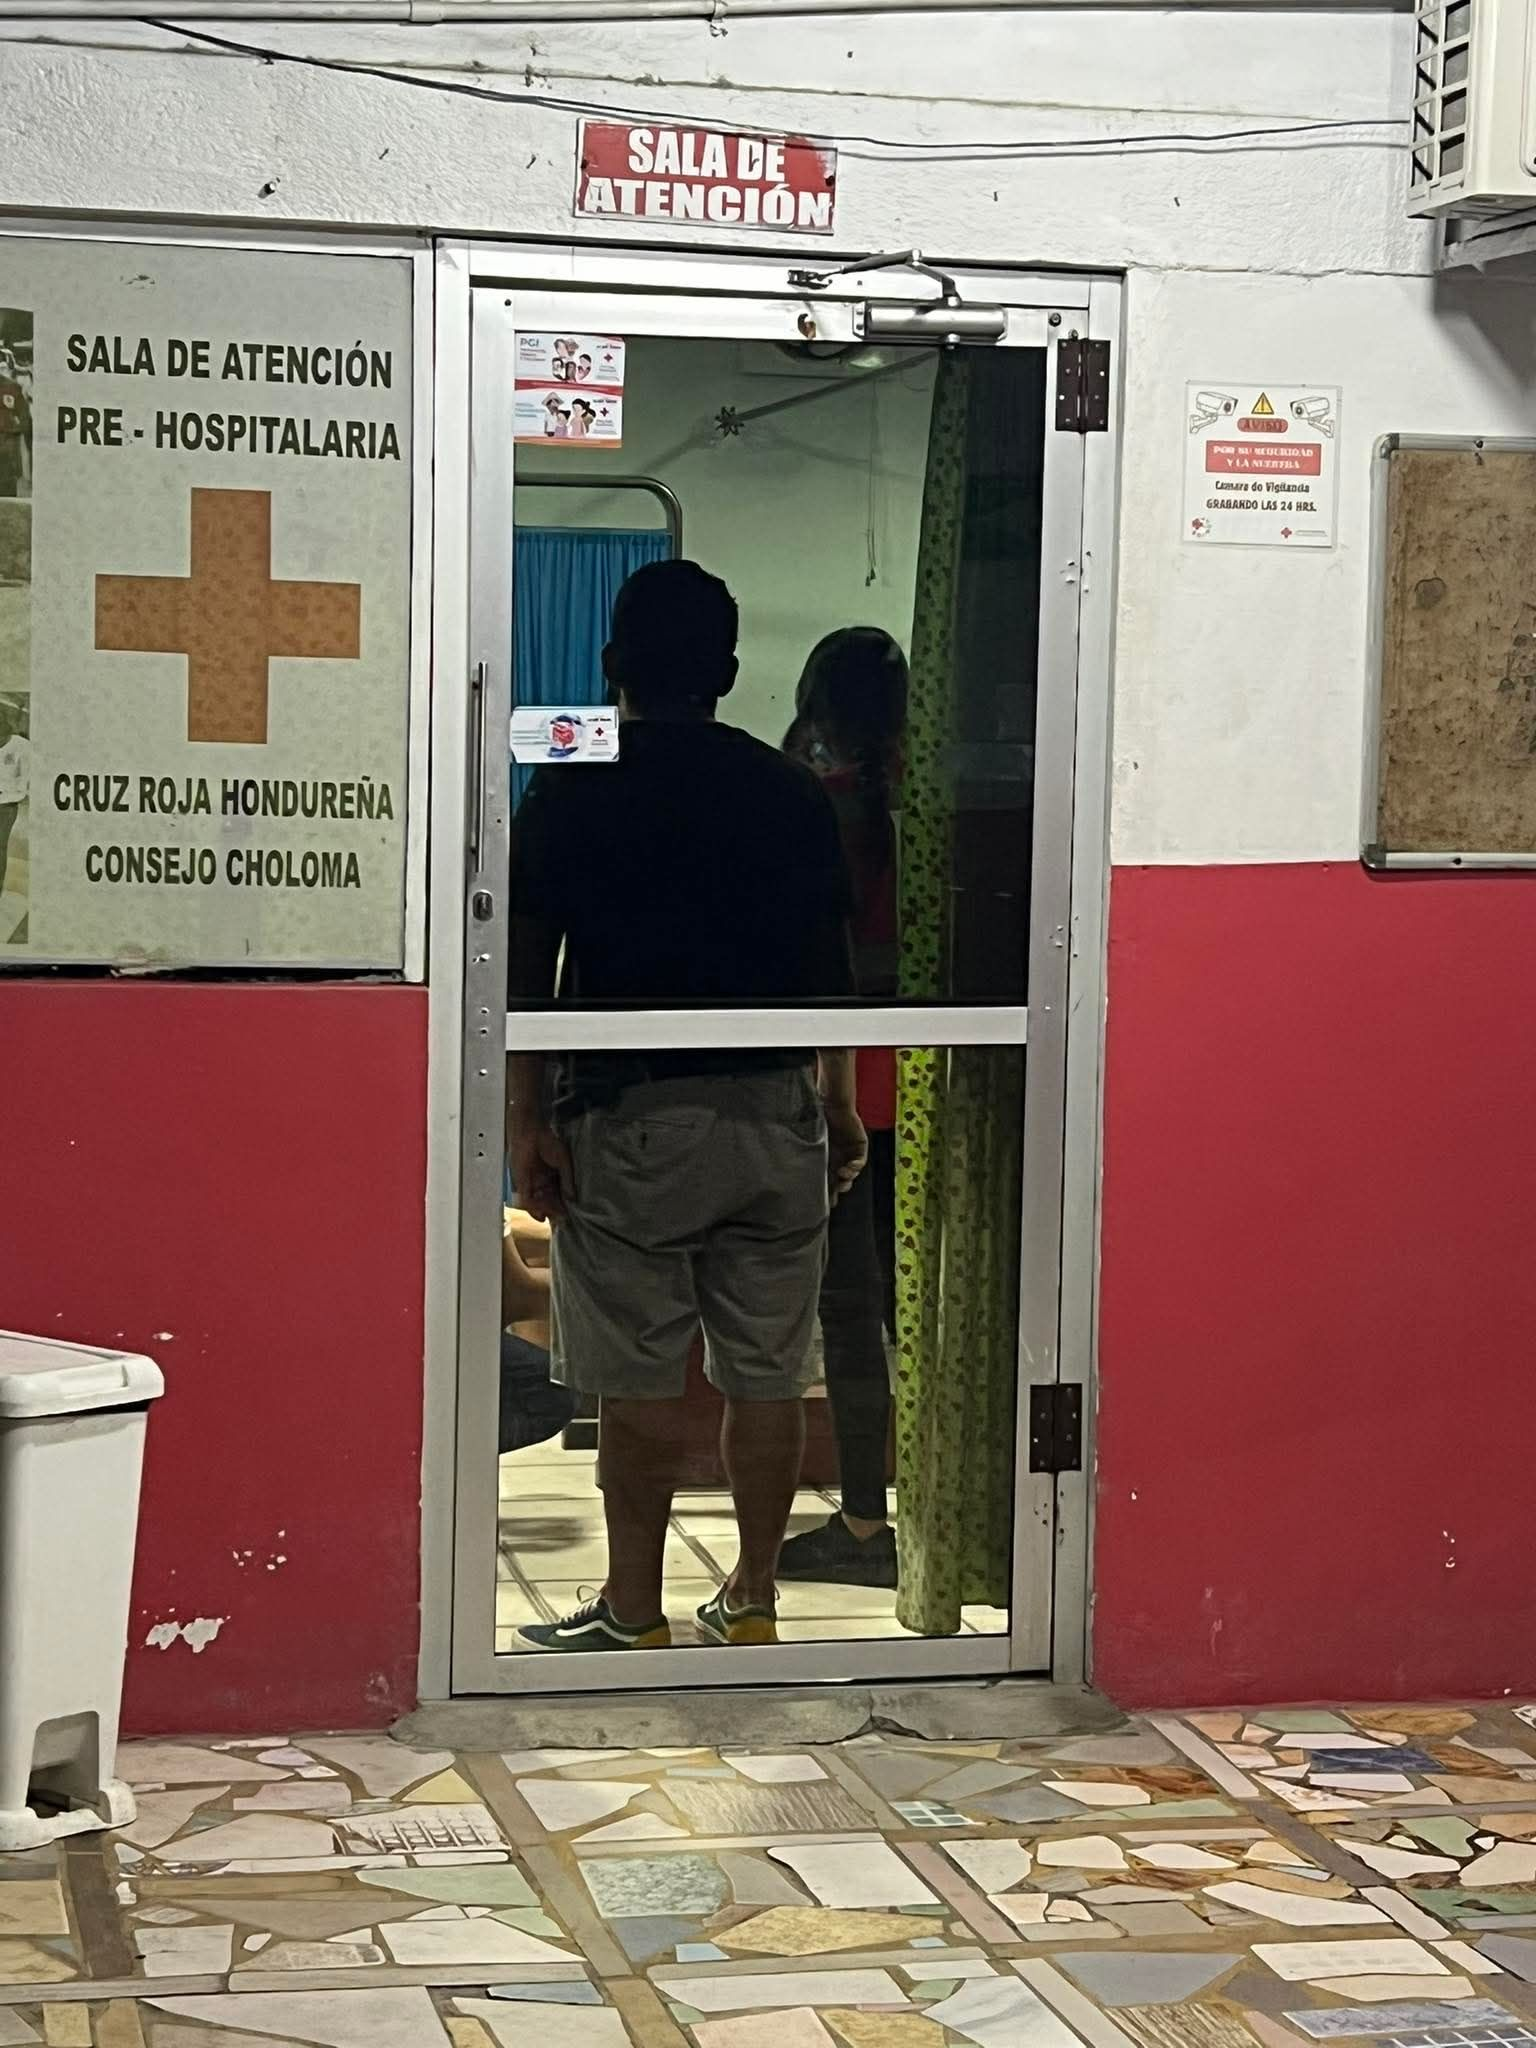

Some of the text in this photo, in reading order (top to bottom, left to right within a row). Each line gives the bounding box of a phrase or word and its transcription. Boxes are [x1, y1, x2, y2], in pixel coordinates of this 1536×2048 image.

[628, 128, 786, 182] SALA DE
[584, 176, 832, 228] ATENCIÓN
[66, 333, 393, 389] SALA DE ATENCIÓN
[57, 405, 124, 447] PRE
[155, 410, 402, 461] HOSPITALARIA
[1226, 458, 1235, 468] Y
[1236, 459, 1250, 469] LA
[1266, 482, 1310, 494] Vigilancia
[1206, 498, 1317, 512] GRABANDO LAS 24 HRS.
[53, 772, 395, 821] CRUZ ROJA HONDUREÑA
[85, 844, 362, 889] CONSEJO CHOLOMA
